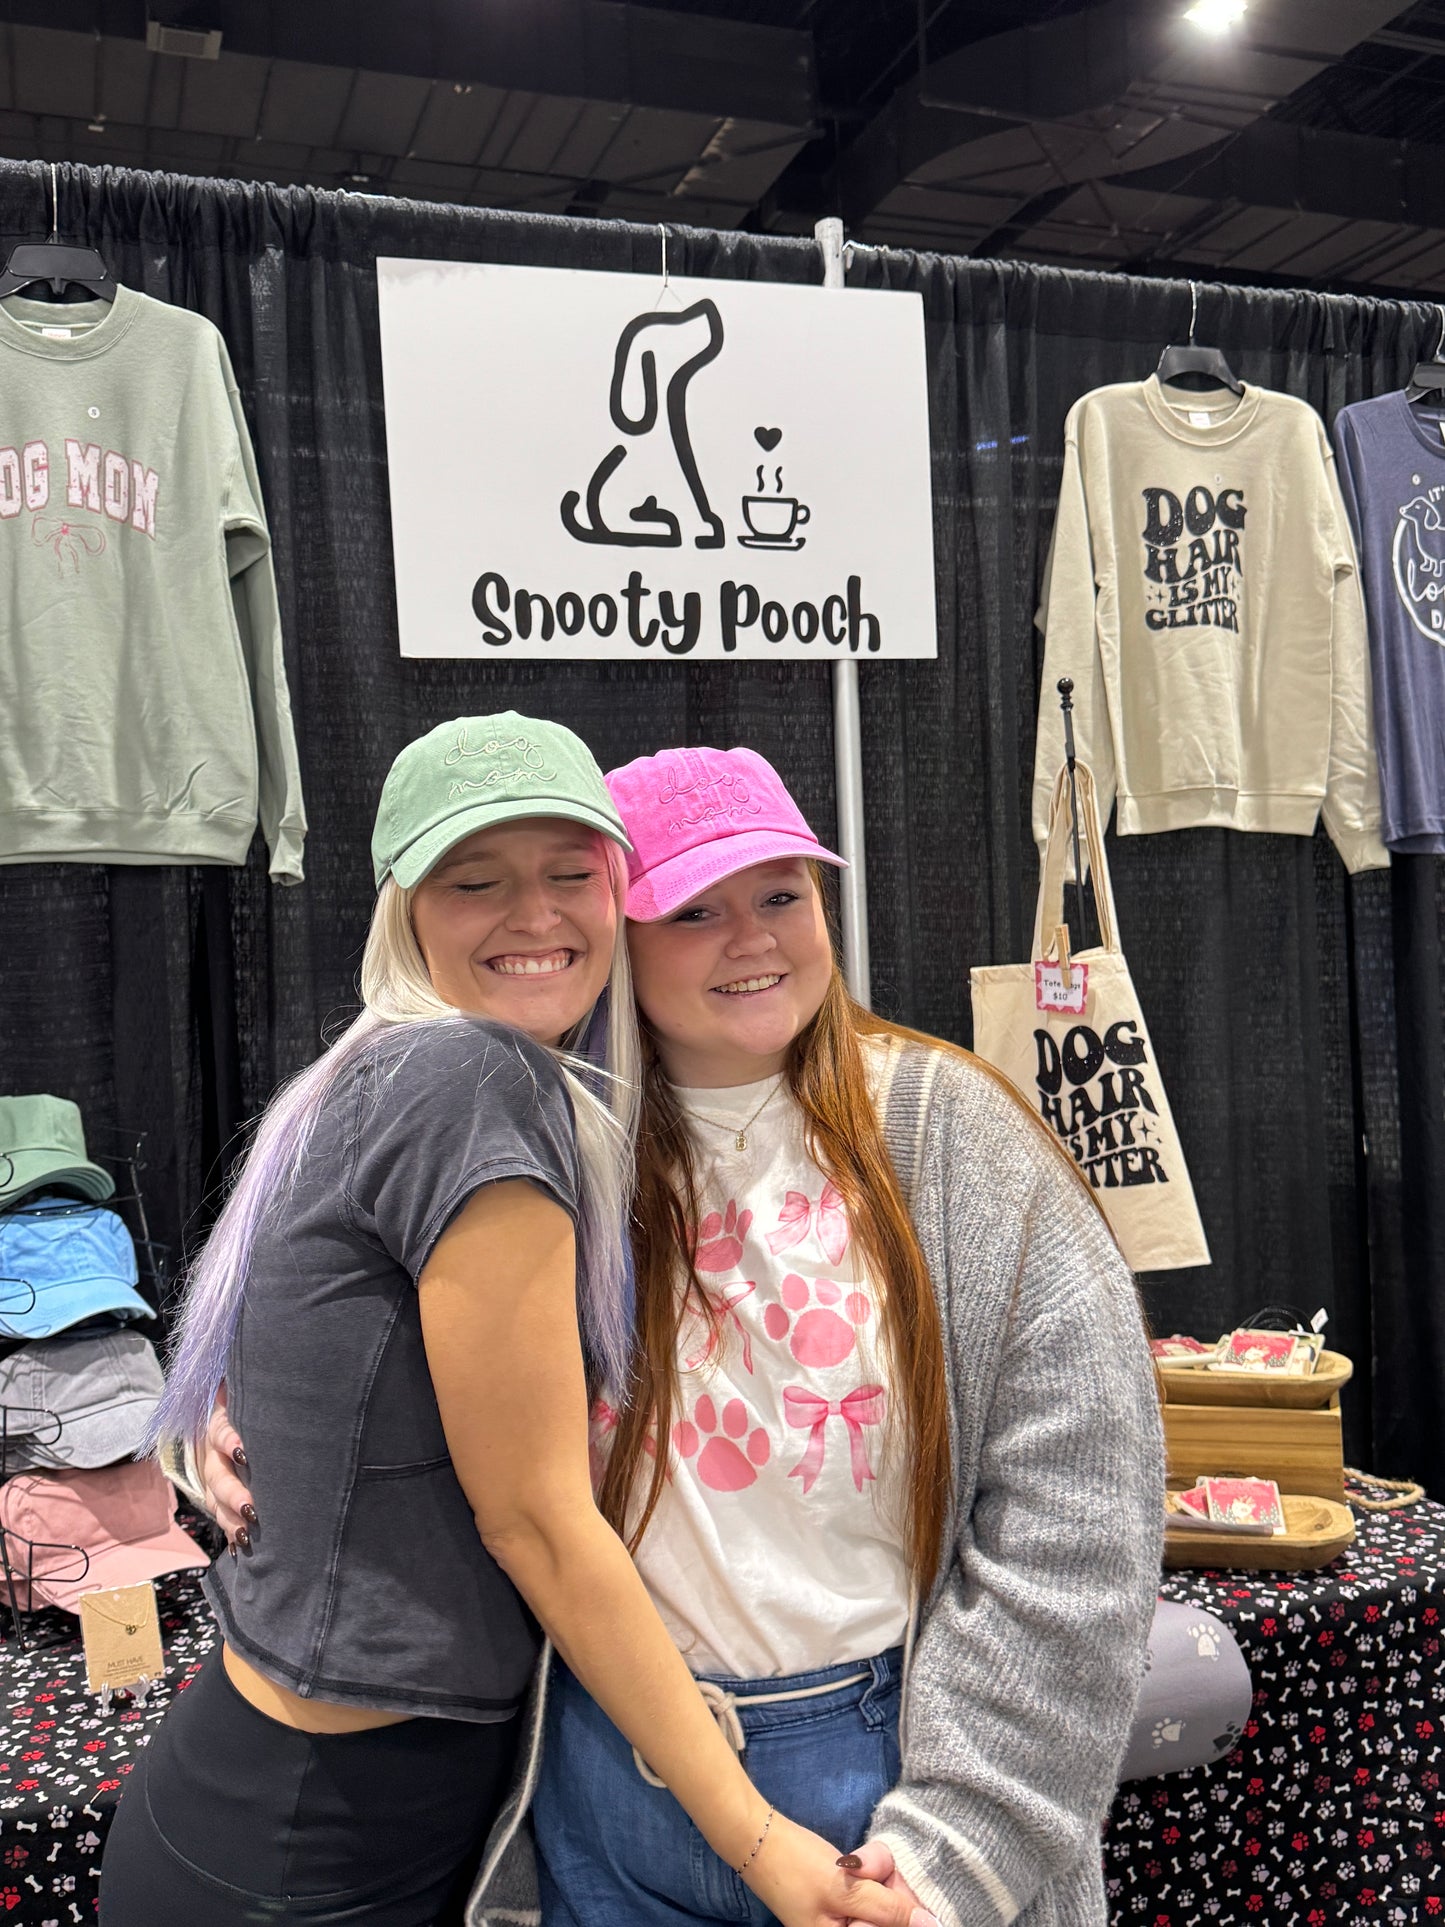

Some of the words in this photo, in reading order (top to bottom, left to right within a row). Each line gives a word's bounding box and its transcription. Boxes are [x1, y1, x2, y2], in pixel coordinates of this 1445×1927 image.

[64, 438, 159, 541] MOM
[1142, 486, 1247, 547] DOG
[1144, 529, 1243, 584] HAIR
[1168, 579, 1199, 608] IS
[1203, 566, 1231, 599] MY
[1407, 558, 1445, 602] lo
[472, 571, 701, 655] Snooty
[1145, 597, 1239, 634] GLITTER
[445, 726, 544, 769] dog
[448, 767, 557, 800] mom
[659, 766, 749, 804] dog
[667, 803, 761, 838] mom
[1044, 979, 1061, 987] Tote
[1053, 992, 1068, 1000] $10
[1033, 1020, 1148, 1096] DOG
[1038, 1068, 1159, 1137] HAIR
[1063, 1135, 1084, 1162] S
[1086, 1111, 1138, 1158] MY
[1081, 1147, 1169, 1188] TTER
